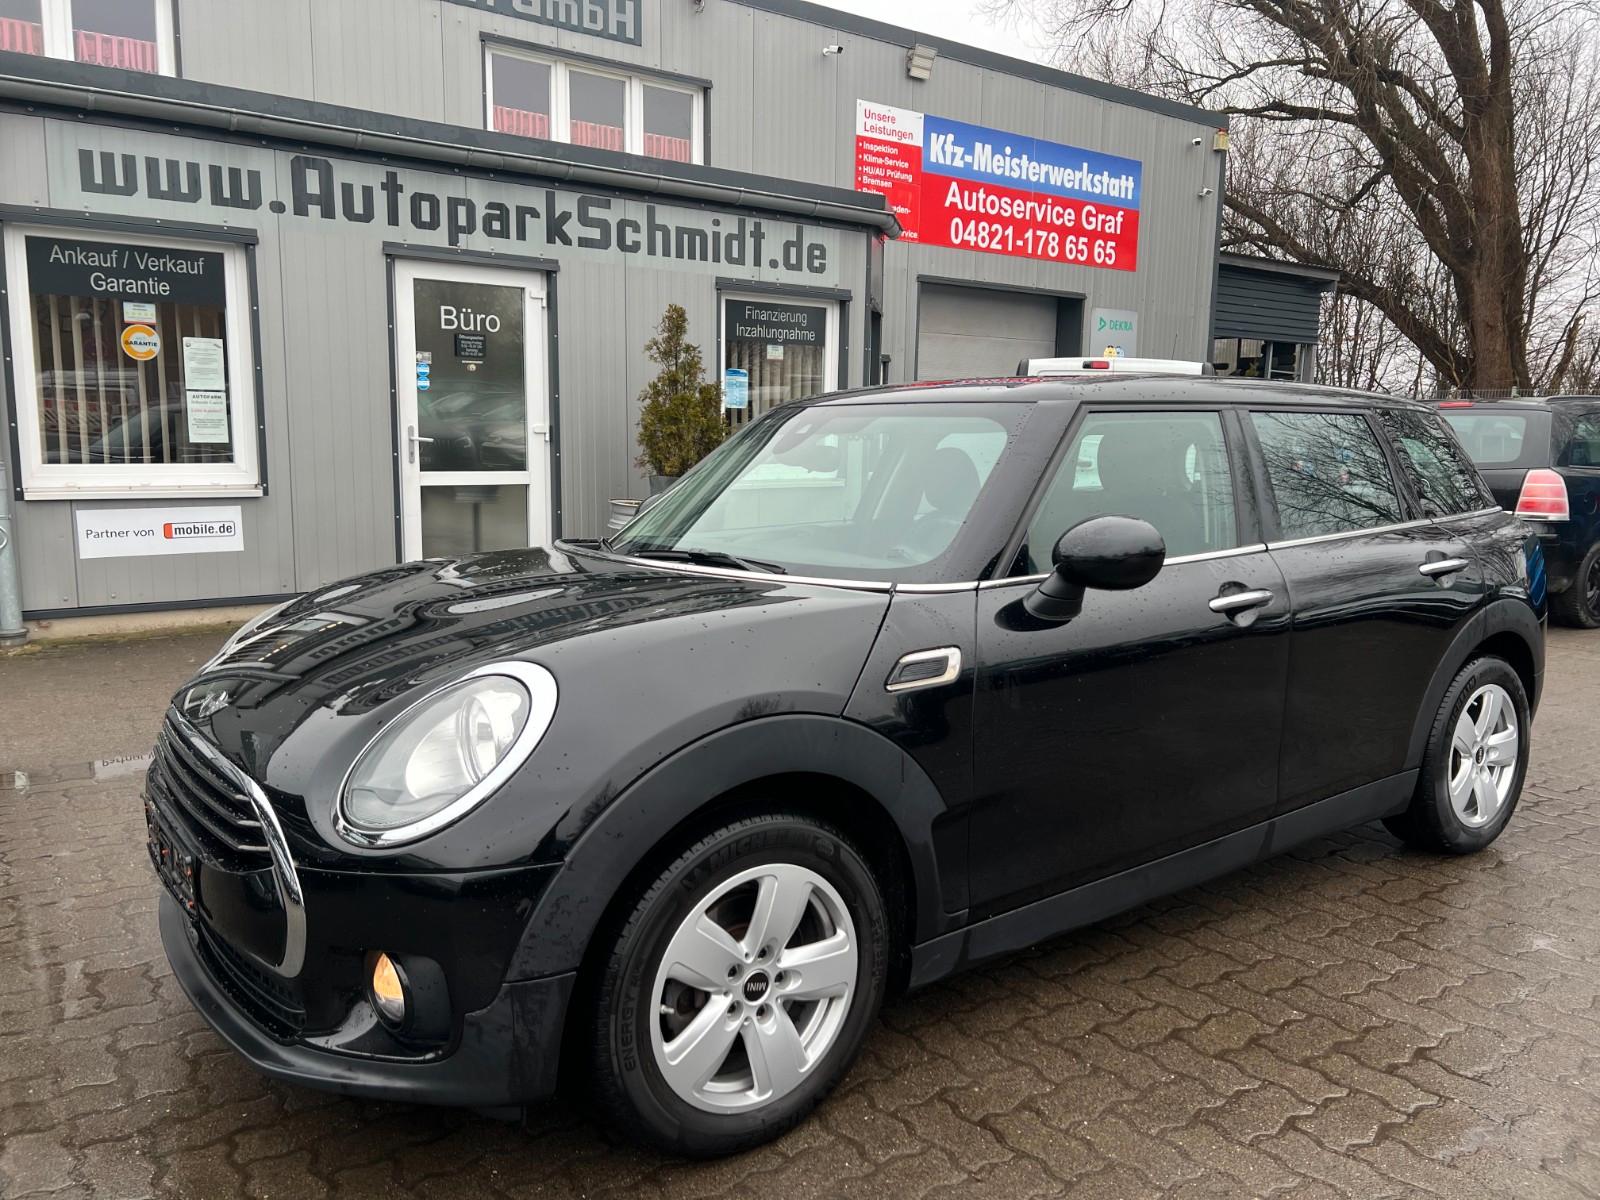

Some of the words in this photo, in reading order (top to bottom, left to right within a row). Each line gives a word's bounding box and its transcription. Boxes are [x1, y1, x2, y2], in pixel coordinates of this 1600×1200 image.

[864, 108, 897, 124] Unsere
[863, 121, 914, 141] Leistungen
[863, 141, 899, 155] Inspektion
[863, 153, 909, 169] Klima-Service
[929, 132, 1135, 200] Kfz-Meisterwerkstatt
[862, 176, 893, 188] Bremsen
[863, 165, 885, 177] HU/AU
[886, 168, 913, 183] Prüfung
[78, 148, 828, 275] www.AutoparkSchmidt.de
[944, 181, 1076, 227] Autoservice
[1081, 205, 1124, 235] Graf
[950, 217, 1060, 258] 04821-178
[1065, 234, 1089, 262] 65
[1093, 239, 1116, 265] 65
[49, 244, 119, 268] Ankauf
[134, 251, 205, 275] Verkauf
[90, 272, 170, 296] Garantie
[440, 305, 501, 333] Büro
[745, 305, 808, 327] Finanzierung
[1109, 319, 1133, 331] DEKRA
[736, 323, 816, 343] Inzahlungnahme
[85, 529, 130, 540] Partner
[133, 528, 155, 538] von
[173, 523, 233, 536] mobile.de
